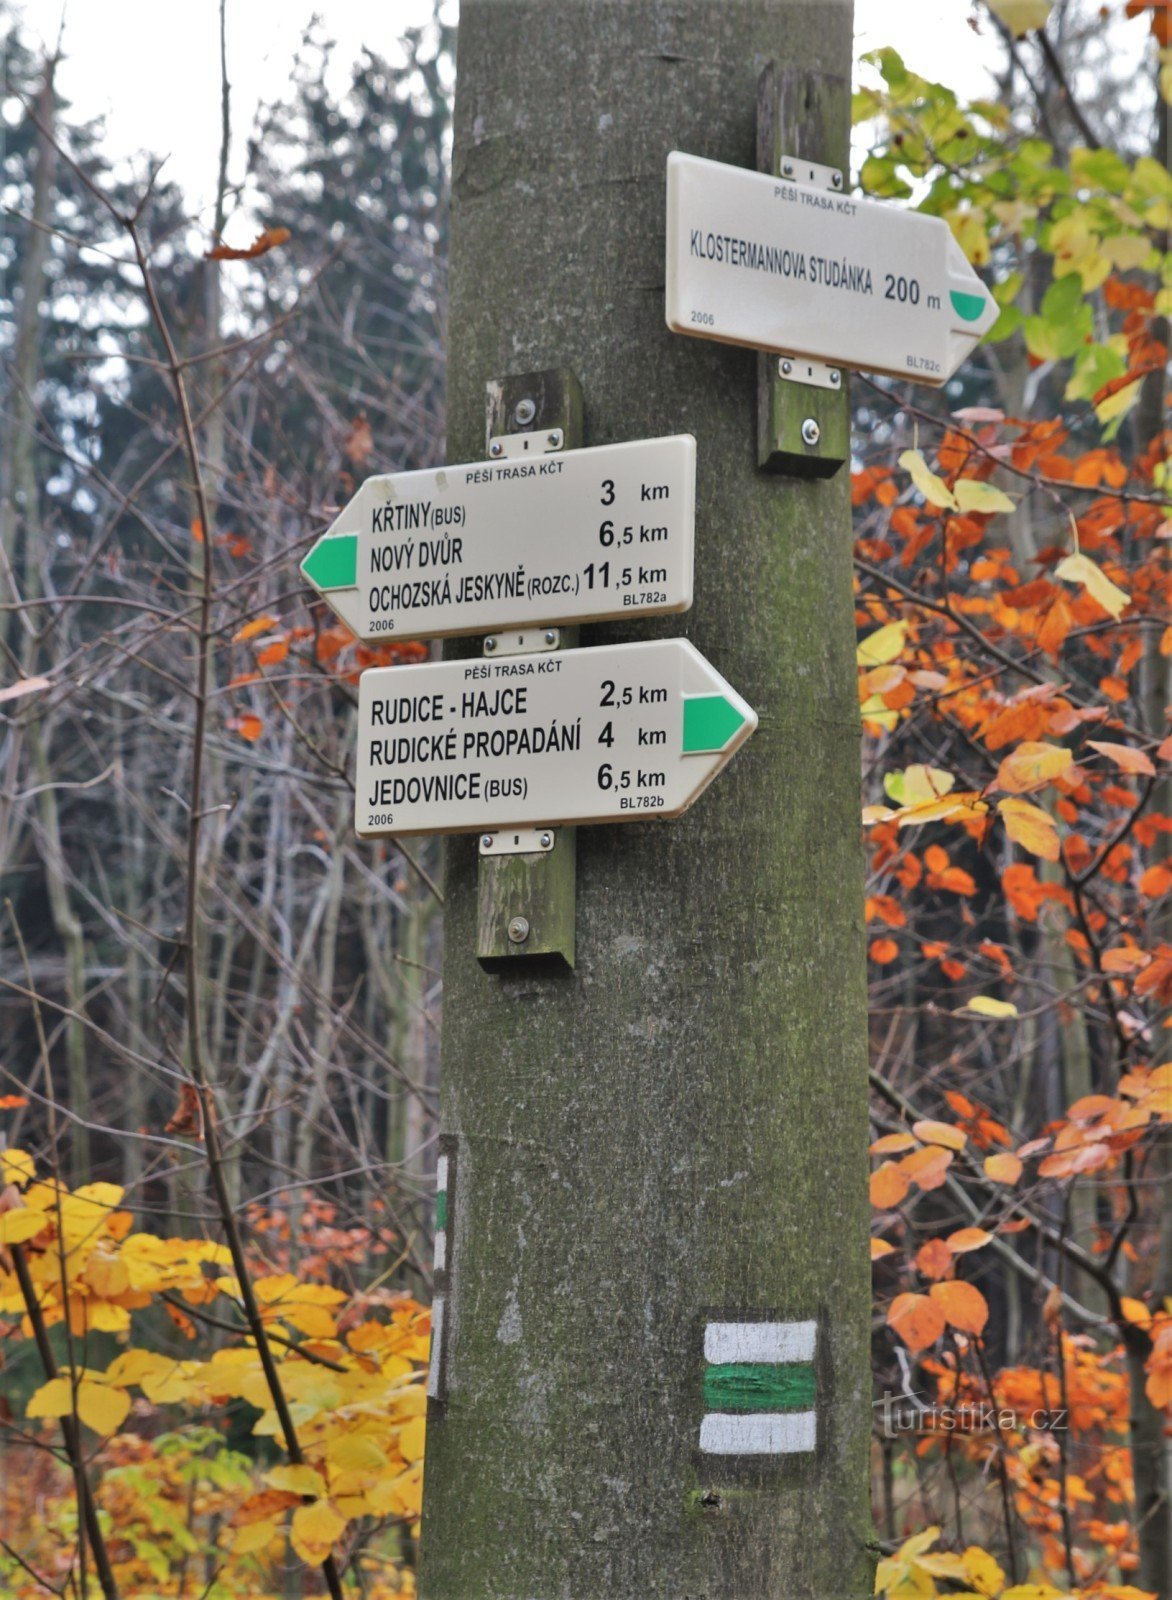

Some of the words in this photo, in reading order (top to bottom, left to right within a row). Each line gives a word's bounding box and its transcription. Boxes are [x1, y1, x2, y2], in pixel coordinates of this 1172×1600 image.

[800, 192, 835, 211] TRASA
[836, 199, 857, 216] KČT
[690, 228, 807, 281] KLOSTERMANNOVA
[809, 251, 874, 295] STUDÁNKA
[884, 274, 920, 305] 200
[927, 294, 941, 310] m
[691, 310, 715, 326] 2006
[906, 355, 941, 372] BL782c
[465, 467, 493, 484] PĚŠÍ
[496, 464, 537, 481] TRASA
[539, 461, 565, 477] KČT
[600, 479, 616, 506] 3
[641, 482, 670, 502] km
[370, 536, 416, 573] NOVÝ
[418, 532, 463, 568] DVŮR
[598, 520, 633, 550] 6,5
[639, 524, 669, 543] km
[368, 567, 451, 613] OCHOZSKÁ
[582, 561, 632, 592] 11,5
[638, 565, 667, 585] km
[622, 592, 667, 607] BL782a
[368, 619, 395, 632] 2006
[464, 664, 492, 681] PĚŠÍ
[494, 662, 535, 679] TRASA
[536, 660, 563, 676] KČT
[371, 694, 444, 726] RUDICE
[462, 687, 527, 718] HAJCE
[599, 680, 633, 709] 2,5
[638, 685, 668, 704] km
[369, 727, 457, 767] RUDICKÉ
[463, 717, 582, 759] PROPADÁNÍ
[597, 721, 615, 748] 4
[637, 726, 667, 747] km
[368, 772, 481, 807] JEDOVNICE
[597, 763, 631, 793] 6,5
[636, 769, 666, 789] km
[619, 796, 665, 810] BL782b
[368, 813, 394, 826] 2006
